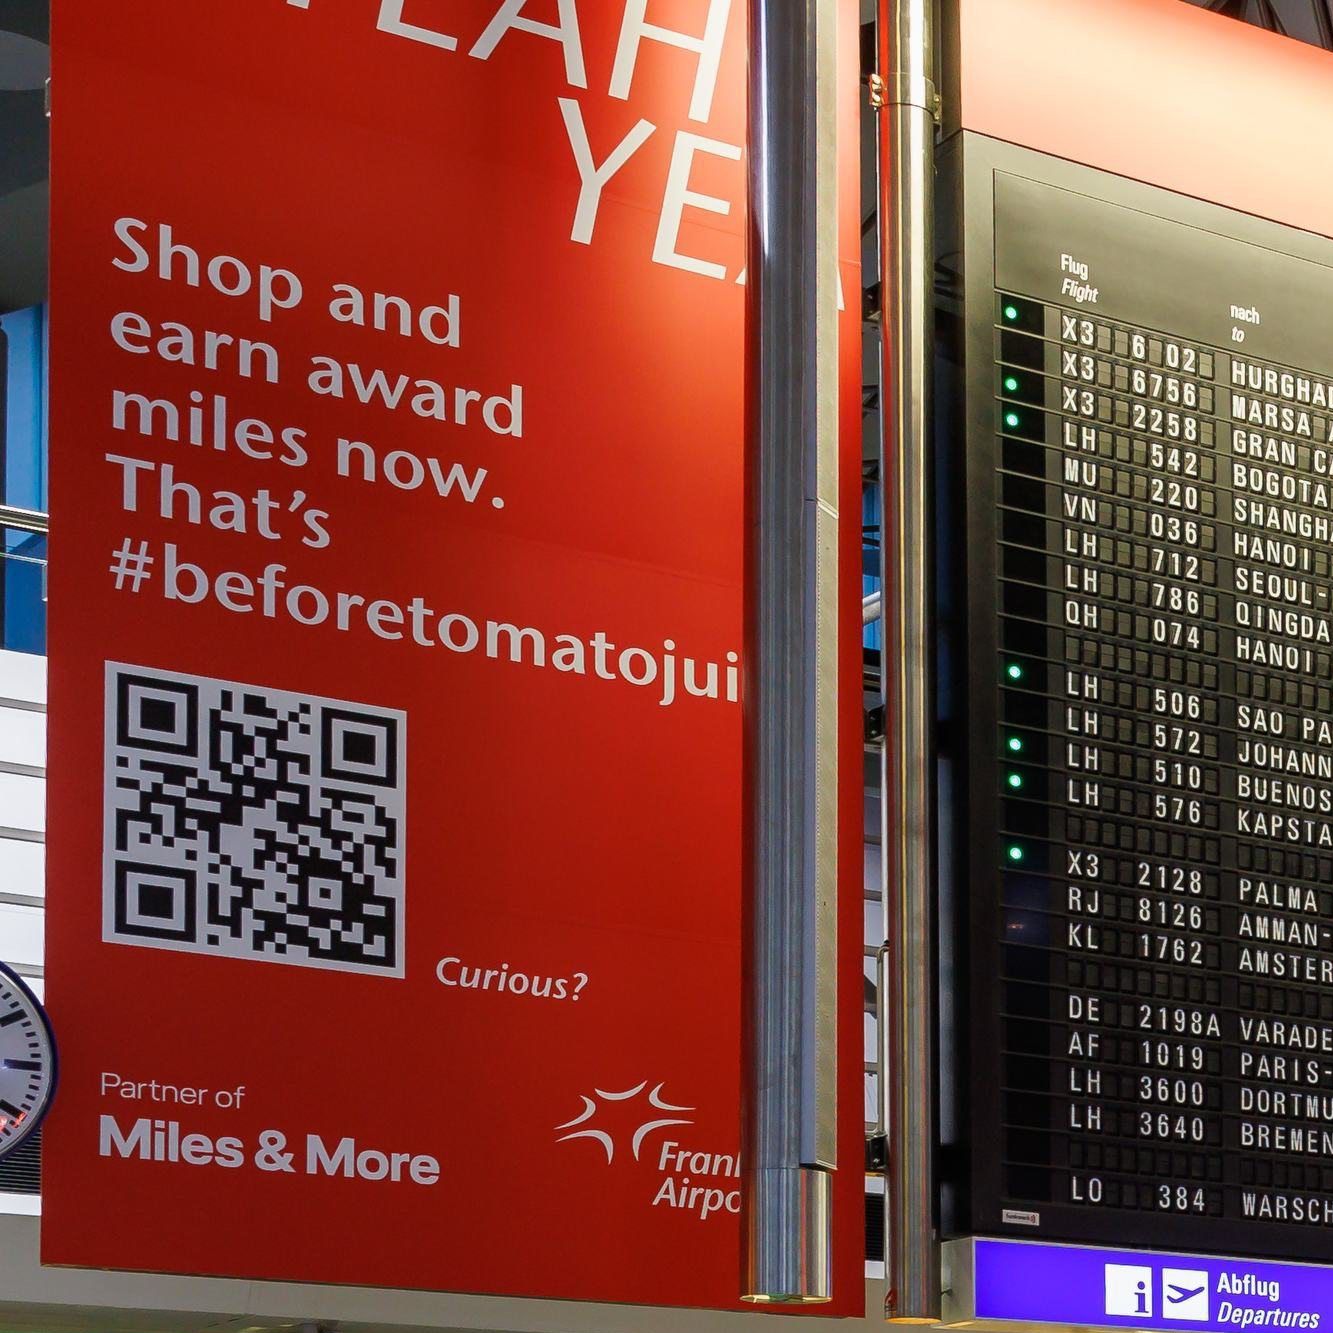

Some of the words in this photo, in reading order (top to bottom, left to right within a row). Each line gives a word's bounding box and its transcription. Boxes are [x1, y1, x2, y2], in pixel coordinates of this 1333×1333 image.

[112, 217, 302, 322] Shop
[329, 278, 461, 348] and
[1060, 253, 1089, 279] Flug
[1062, 278, 1098, 303] Flight
[1230, 304, 1259, 324] nach
[1232, 326, 1244, 343] to
[110, 312, 279, 383] earn
[308, 355, 524, 437] award
[1232, 395, 1310, 435] MARSA
[113, 390, 308, 466] miles
[338, 437, 505, 508] now.
[1232, 430, 1295, 465] GRAN
[1065, 458, 1096, 486] MU
[1151, 479, 1197, 509] 220
[1233, 464, 1327, 507] BOGOTA
[1234, 533, 1308, 570] HANOI
[109, 538, 739, 706] #beforetomatojui
[1236, 637, 1310, 672] HANOI
[1237, 706, 1282, 734] SAO
[1238, 775, 1331, 811] BUENOS
[1239, 879, 1317, 911] PALMA
[436, 957, 587, 1002] Curious?
[101, 1073, 206, 1108] Partner
[214, 1080, 245, 1108] of
[98, 1115, 245, 1168] Miles
[255, 1130, 295, 1173] &
[306, 1136, 440, 1185] More
[653, 1178, 740, 1220] Airpo
[1217, 1273, 1280, 1303] Abflug
[1218, 1302, 1320, 1332] Departures
